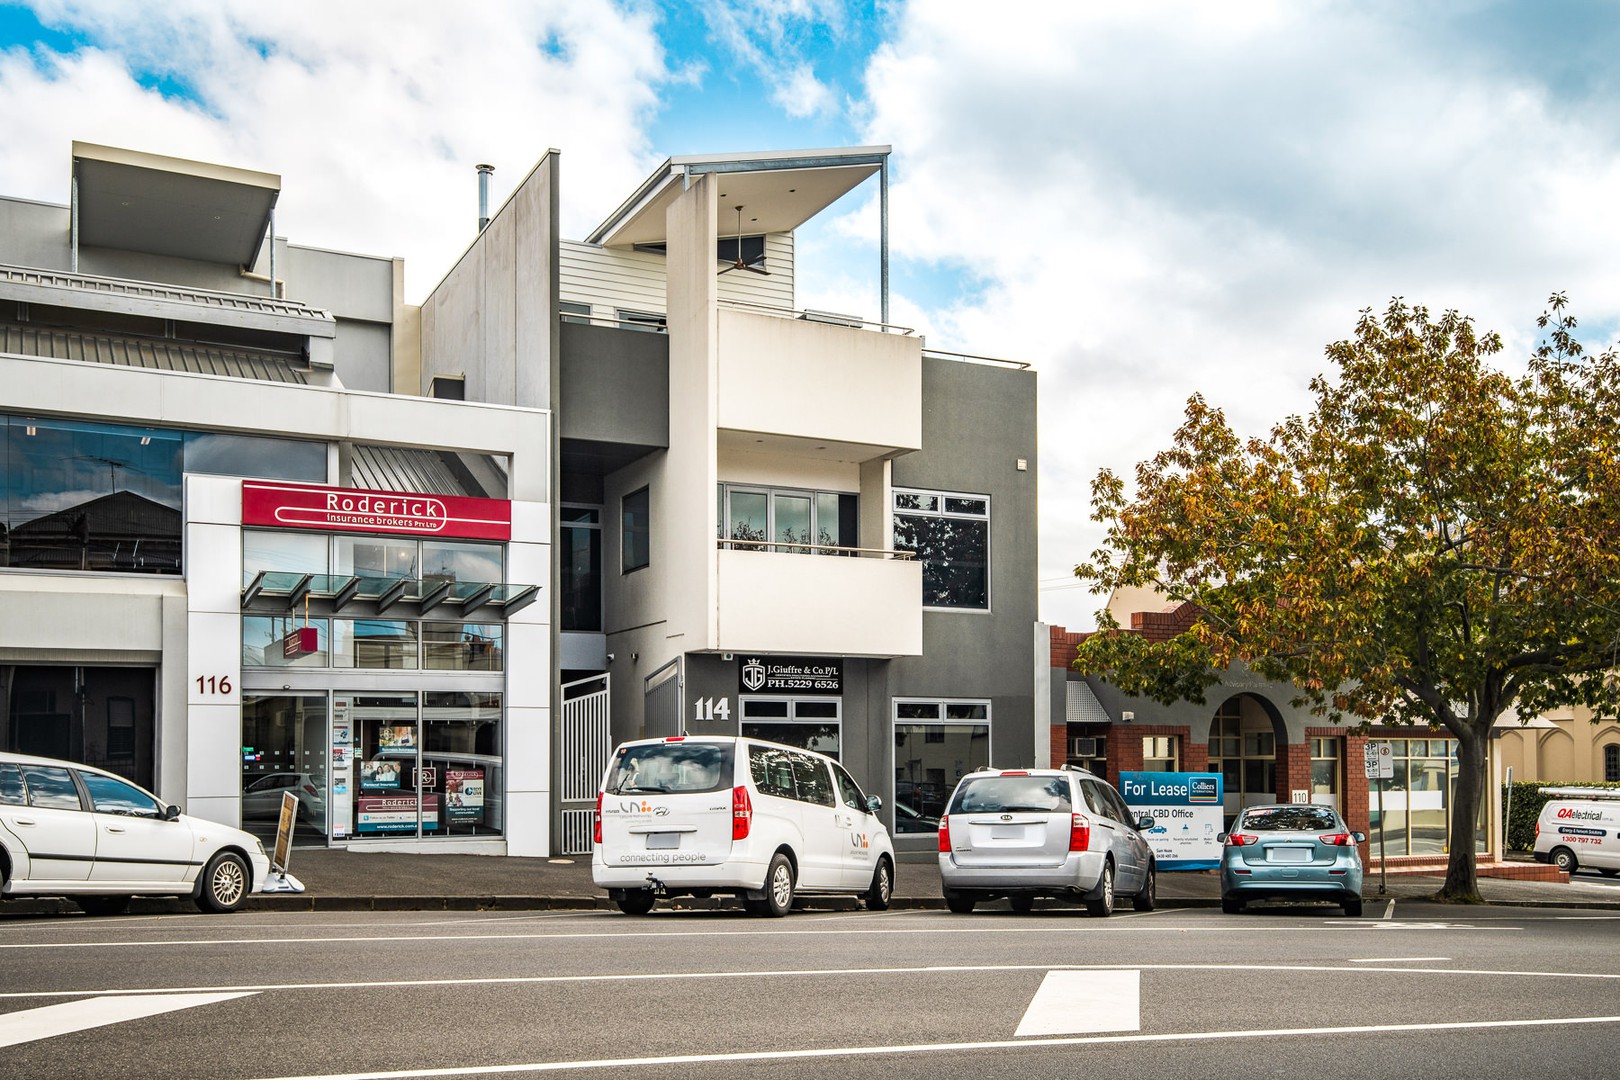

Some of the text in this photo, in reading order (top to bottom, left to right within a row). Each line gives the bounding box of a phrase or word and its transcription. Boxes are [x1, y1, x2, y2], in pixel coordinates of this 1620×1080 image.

[327, 493, 437, 517] Roderick
[376, 516, 413, 527] brokers
[767, 665, 802, 675] J.Giuffre
[803, 666, 811, 674] &
[196, 675, 232, 695] 116
[767, 679, 839, 689] PH.5229 6526
[694, 696, 731, 721] 114
[1365, 743, 1377, 751] 3P
[1366, 760, 1378, 769] 3P
[1124, 780, 1188, 796] For Lease
[1191, 781, 1215, 790] Colliers
[1293, 792, 1307, 803] 110
[1130, 809, 1194, 818] entral CBD Office
[620, 852, 707, 864] connecting people
